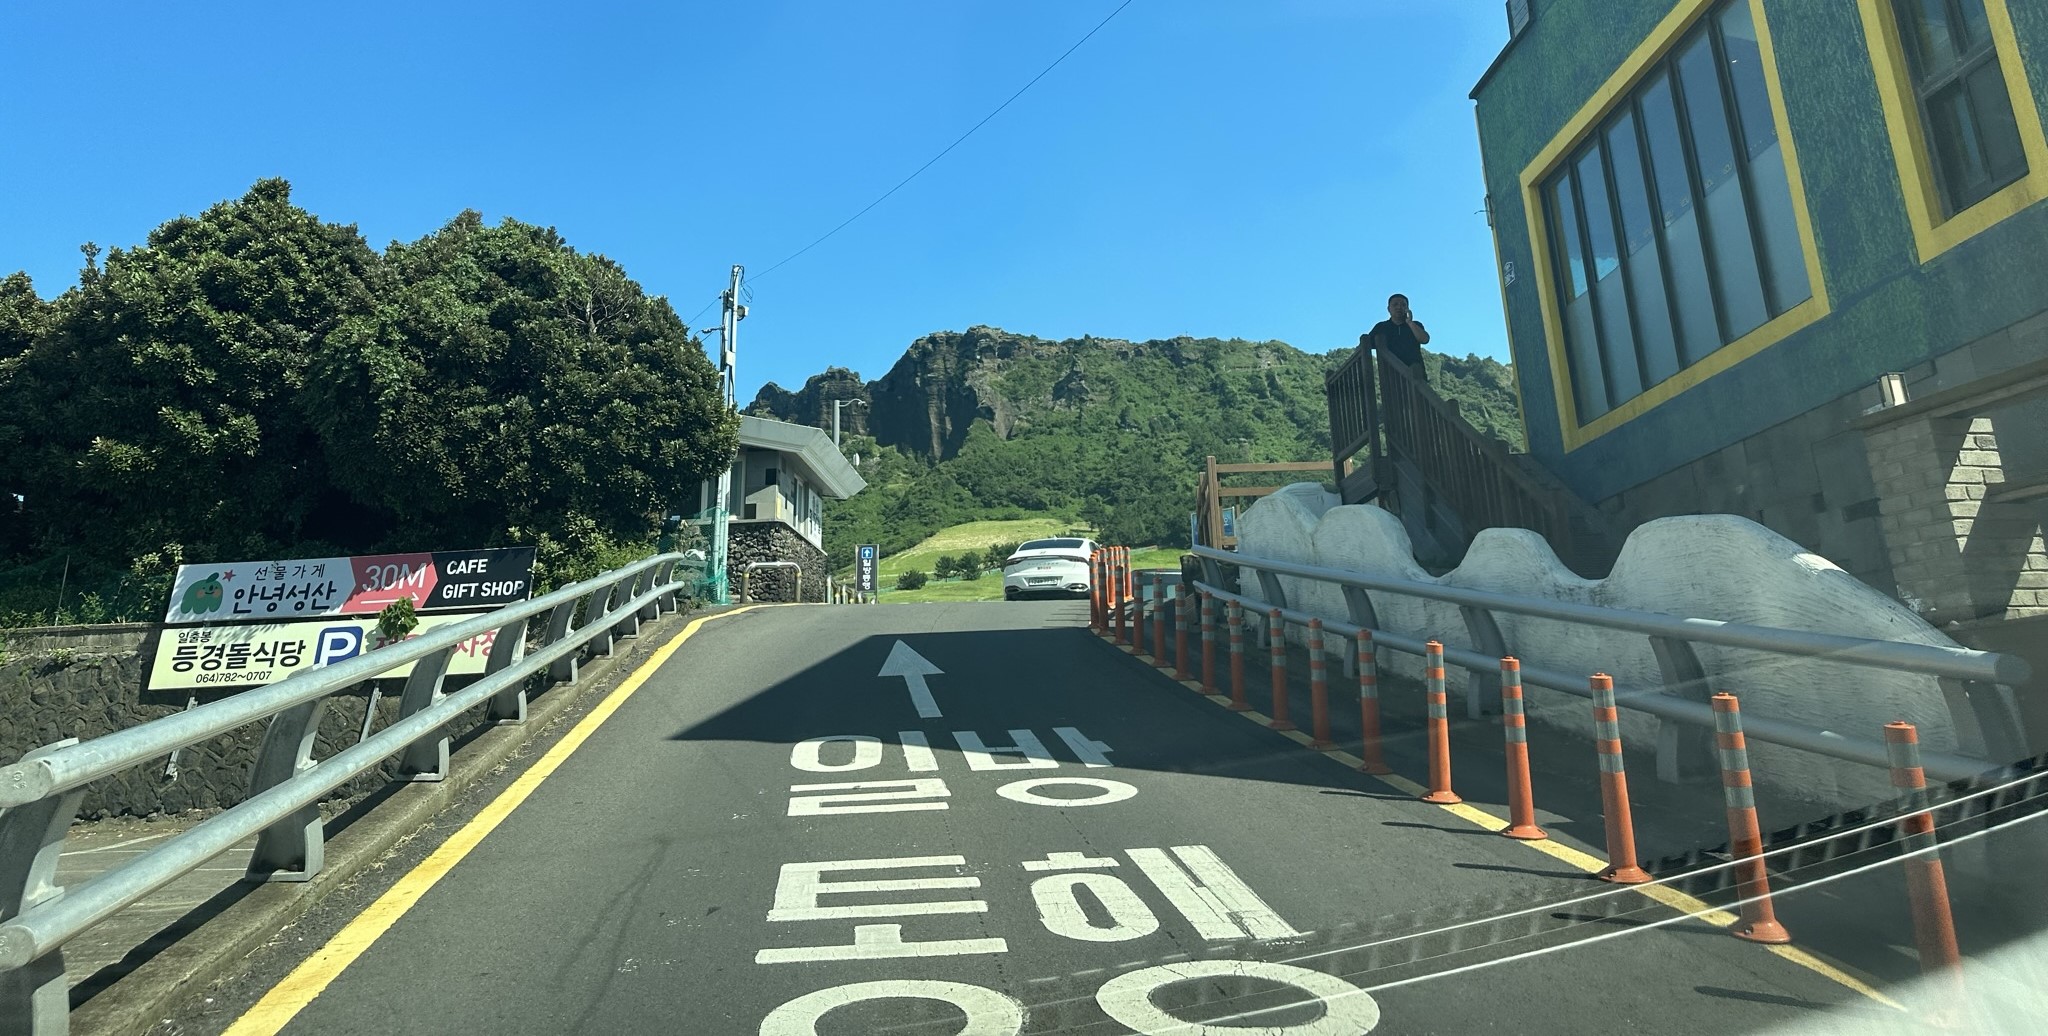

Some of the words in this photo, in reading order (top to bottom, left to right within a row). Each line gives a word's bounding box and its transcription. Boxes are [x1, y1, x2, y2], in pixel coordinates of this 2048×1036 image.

[362, 562, 427, 592] 30M
[446, 558, 489, 575] CAFE
[232, 580, 337, 614] 안녕성산
[442, 582, 479, 599] GIFT
[480, 580, 525, 597] SHOP
[178, 630, 212, 644] 일출봉
[172, 639, 306, 673] 등경돌식당
[787, 726, 1139, 817] 일방
[755, 844, 1381, 1036] 통행
